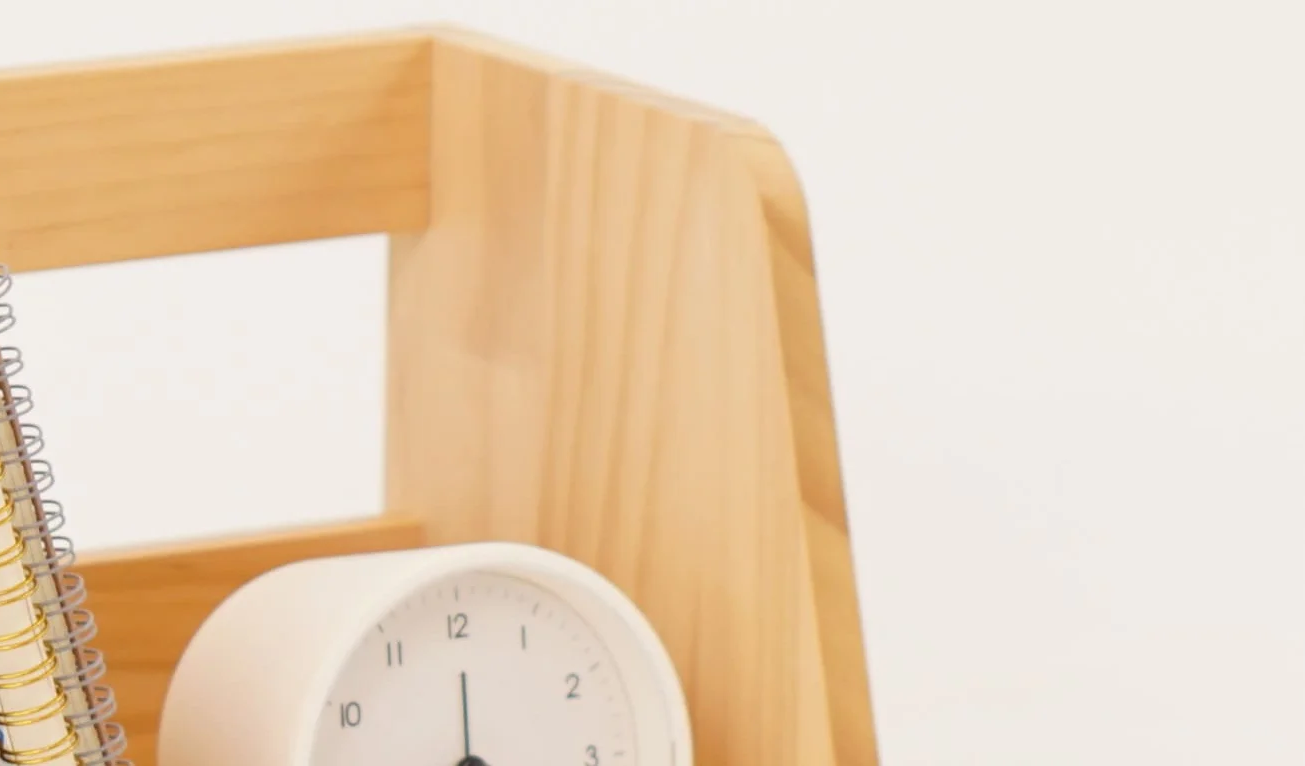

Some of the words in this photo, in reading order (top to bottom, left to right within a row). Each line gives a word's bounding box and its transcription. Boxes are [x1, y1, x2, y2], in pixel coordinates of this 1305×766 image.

[447, 612, 470, 640] 12
[520, 624, 527, 651] 1
[386, 640, 403, 667] 11
[565, 672, 581, 699] 2
[339, 701, 362, 729] 10
[584, 743, 600, 766] 3
